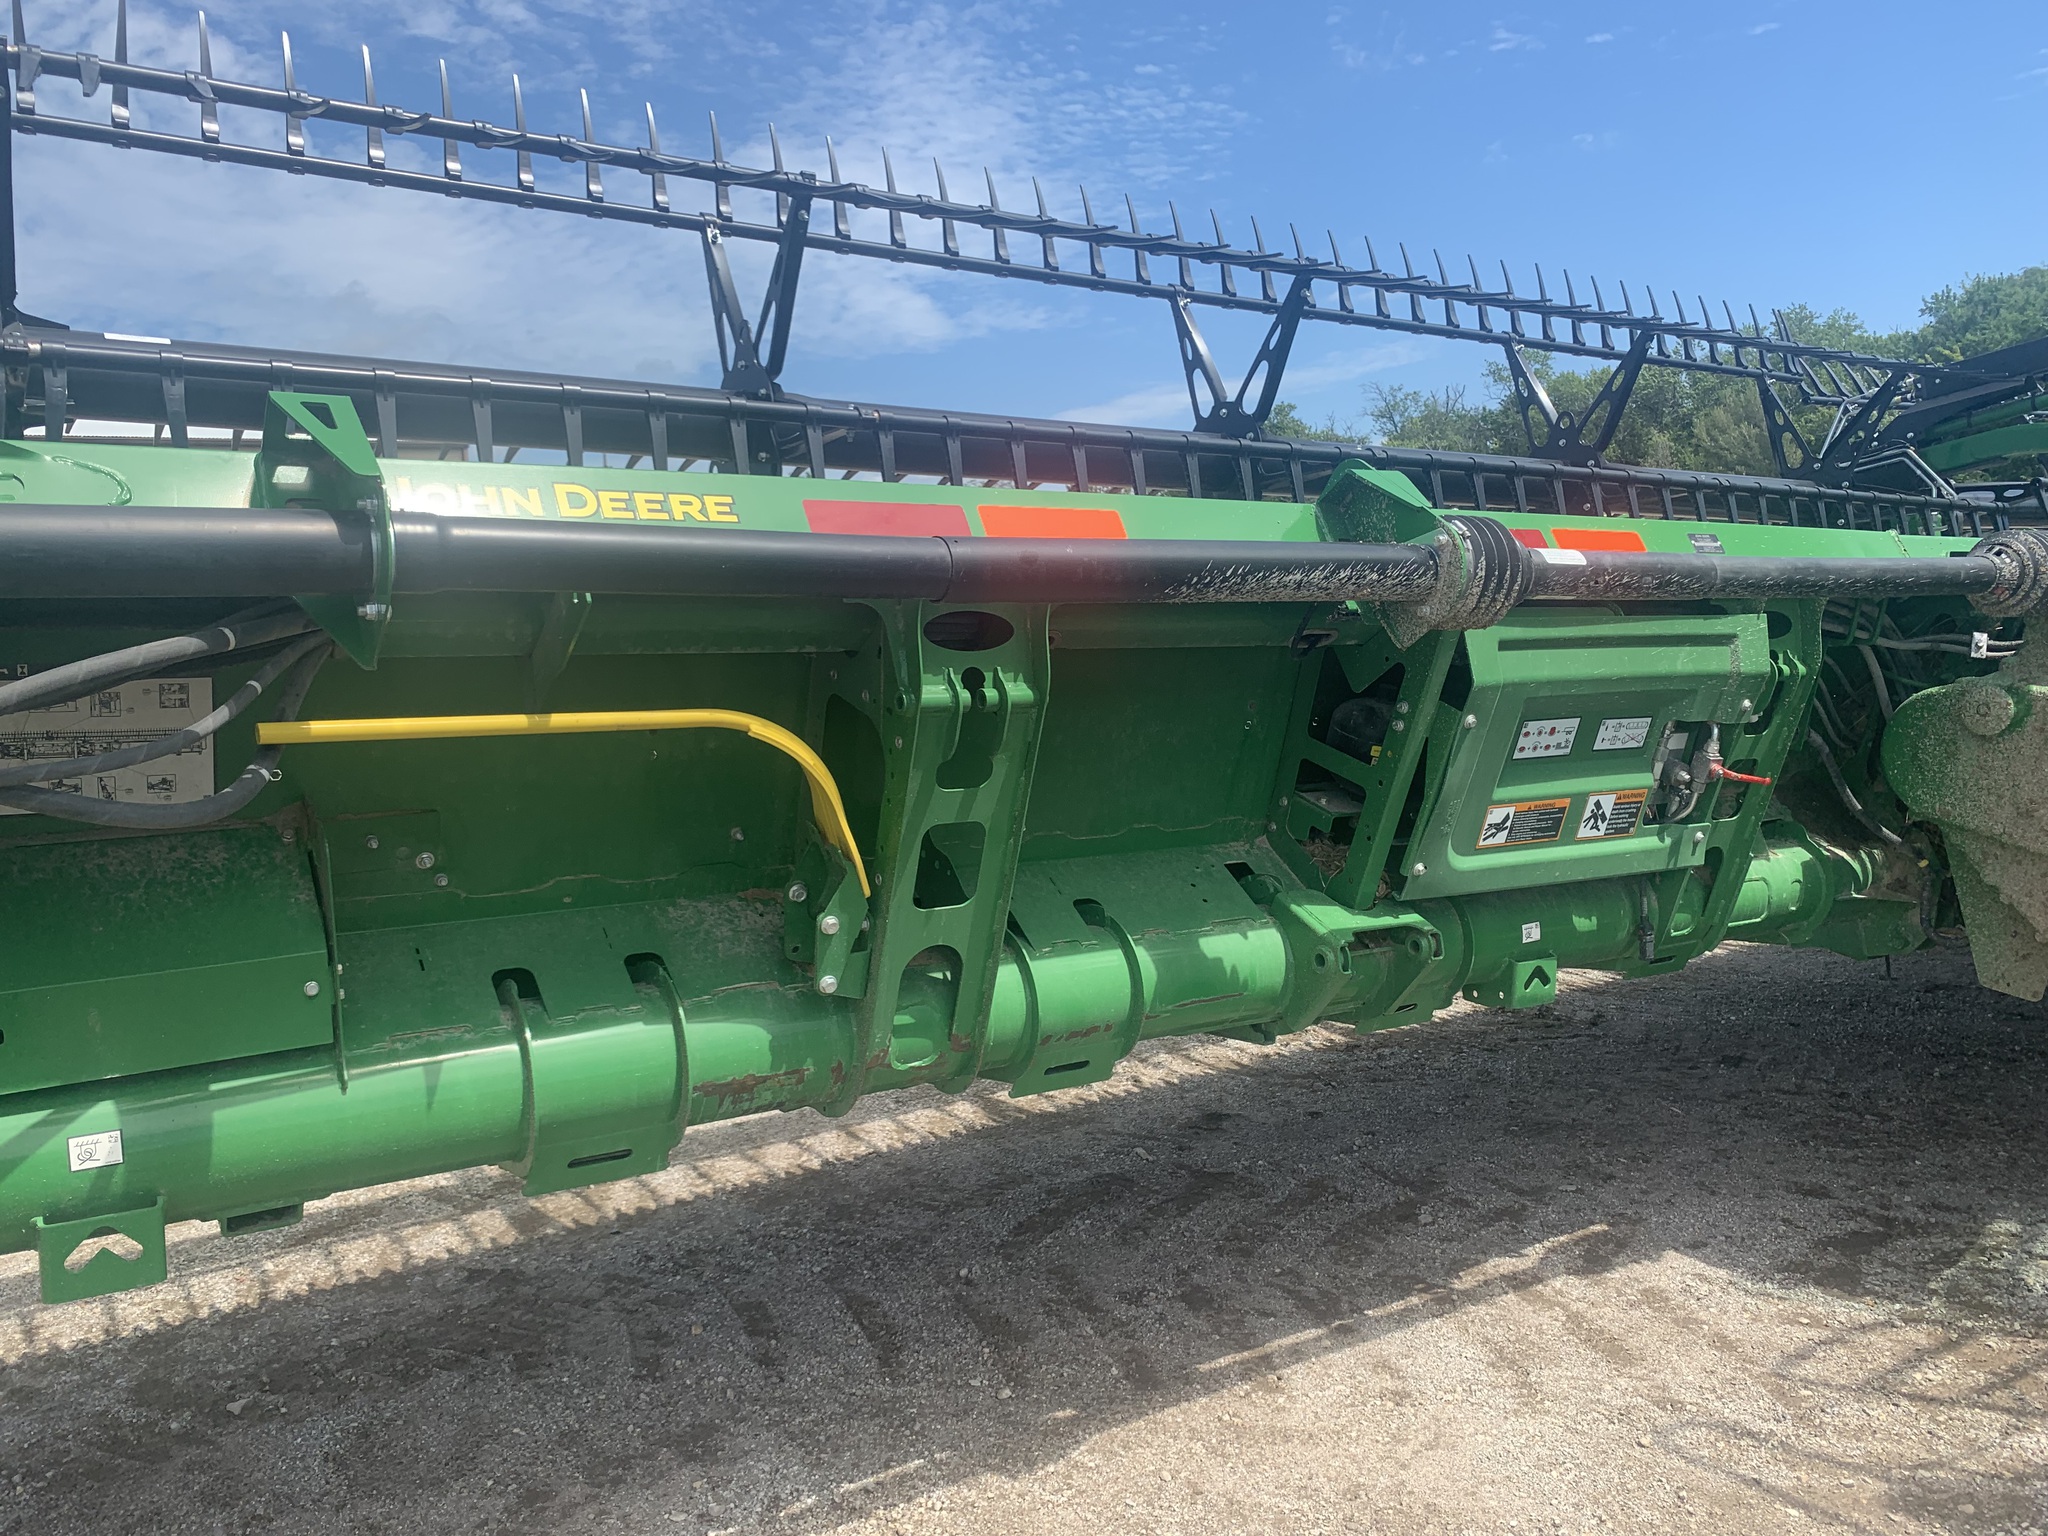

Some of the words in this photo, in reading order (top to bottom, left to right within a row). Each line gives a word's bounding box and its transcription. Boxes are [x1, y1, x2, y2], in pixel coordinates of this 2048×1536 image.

[552, 481, 741, 524] DEERE
[1622, 791, 1646, 800] WARNING
[1533, 801, 1556, 809] WARNING
